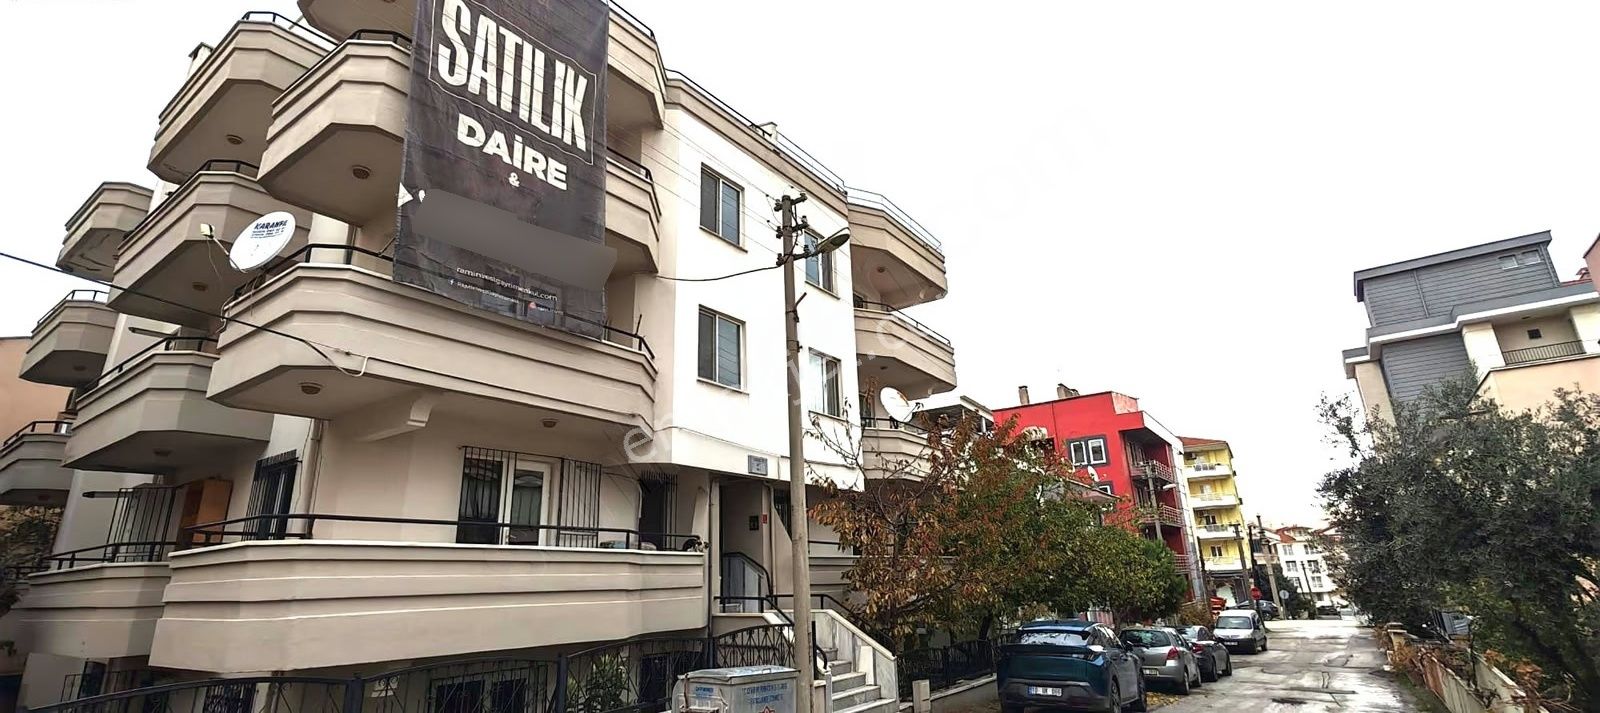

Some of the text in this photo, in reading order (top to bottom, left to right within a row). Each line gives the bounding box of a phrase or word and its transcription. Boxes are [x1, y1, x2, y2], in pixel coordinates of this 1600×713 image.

[437, 0, 588, 153] SATILIK
[457, 113, 567, 191] DAİRE
[508, 172, 520, 188] &
